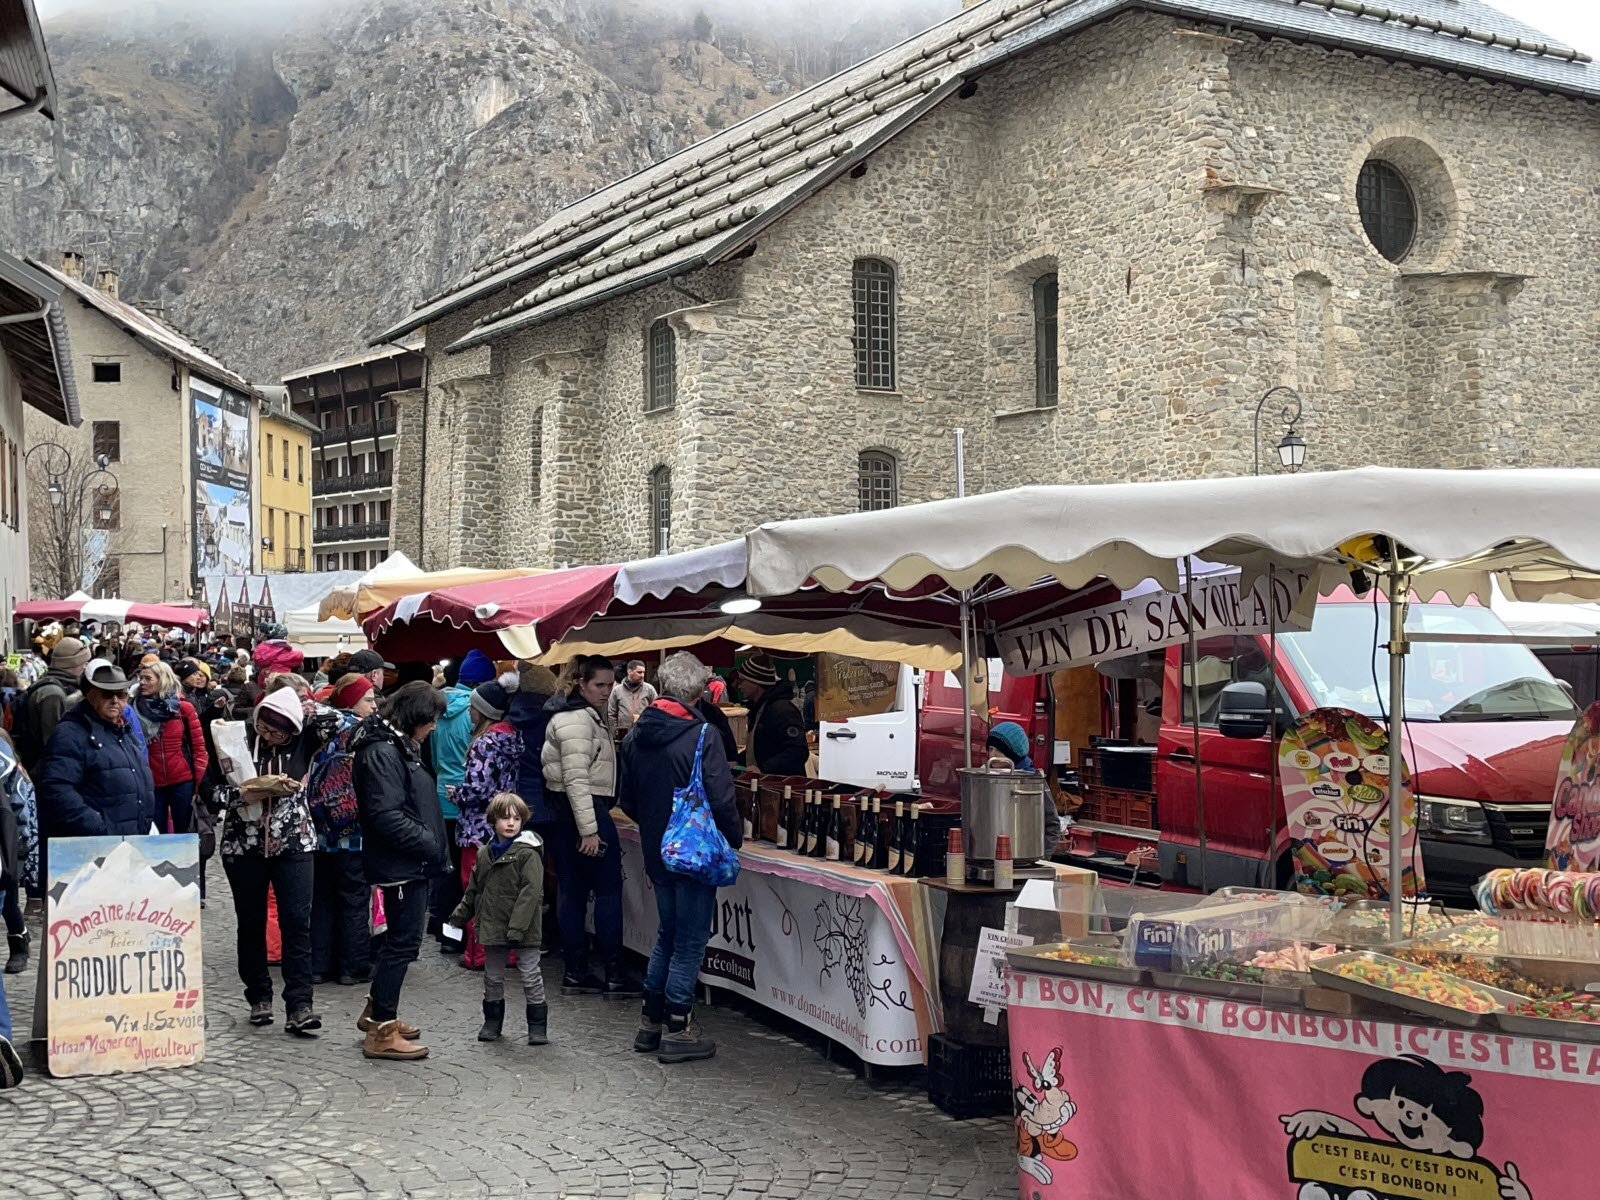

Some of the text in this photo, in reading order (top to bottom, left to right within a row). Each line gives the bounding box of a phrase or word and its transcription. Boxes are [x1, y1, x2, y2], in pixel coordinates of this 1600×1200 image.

[1014, 623, 1073, 670] VIN
[1084, 609, 1133, 657] DE
[1145, 583, 1246, 643] SAVOIE
[1335, 815, 1365, 831] Fini
[49, 904, 124, 958] Domaine
[125, 901, 136, 922] de
[1143, 925, 1174, 944] Fini
[54, 949, 187, 1000] PRODUCTEUR
[707, 953, 752, 981] récoltant
[105, 1009, 205, 1034] Vin de Savoie
[771, 986, 923, 1053] www.domainedelorbert.com
[1039, 977, 1114, 1014] BON,
[1126, 988, 1209, 1024] C'EST
[1222, 1002, 1379, 1047] BONBON
[49, 1034, 200, 1065] Artisan Vigneron Apiculteur
[1311, 1143, 1484, 1184] C'EST BEAU, C'EST BON,
[1339, 1165, 1375, 1181] C'EST
[1382, 1173, 1447, 1195] BONBON
